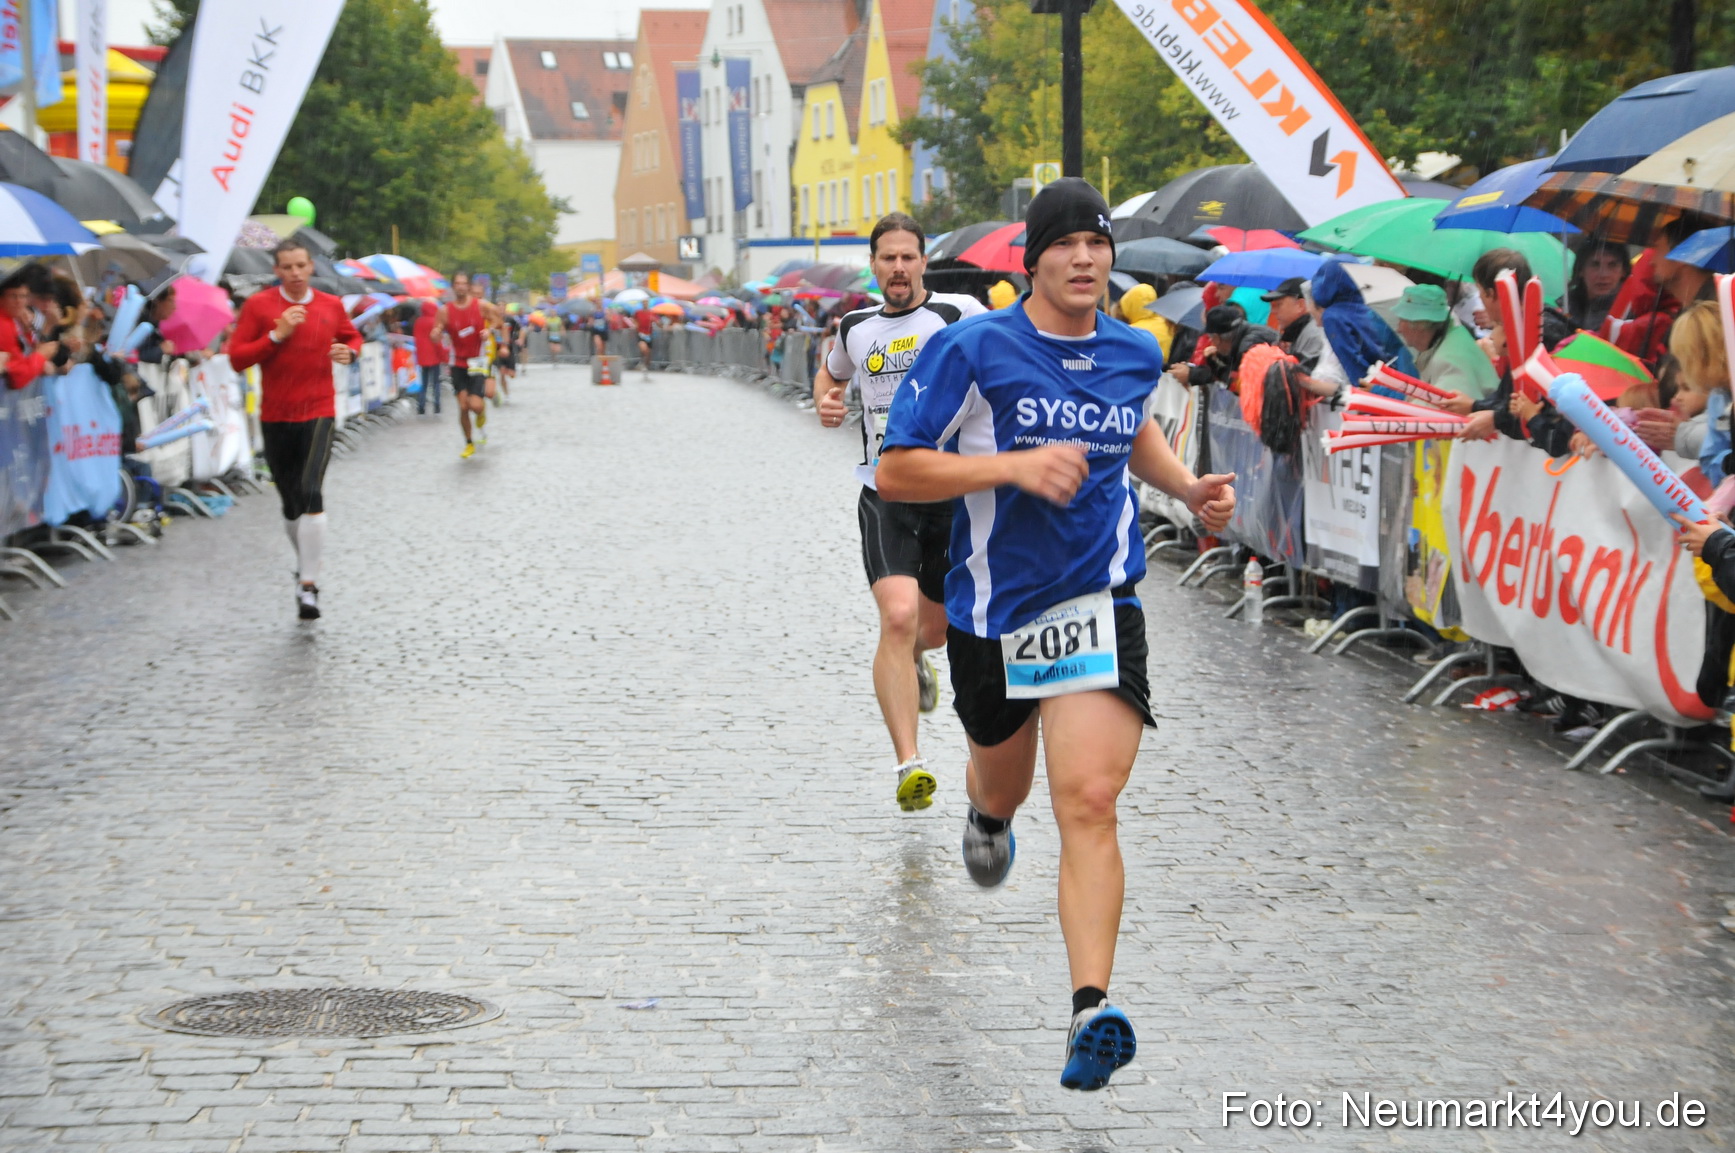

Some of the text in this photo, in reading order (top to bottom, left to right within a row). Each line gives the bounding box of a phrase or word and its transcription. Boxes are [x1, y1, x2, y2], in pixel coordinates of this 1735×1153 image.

[211, 17, 283, 192] Audi BKK
[892, 337, 914, 352] TEAM
[1062, 359, 1092, 371] PUMA
[1017, 397, 1136, 435] SYSCAD
[1014, 617, 1099, 660] 2081
